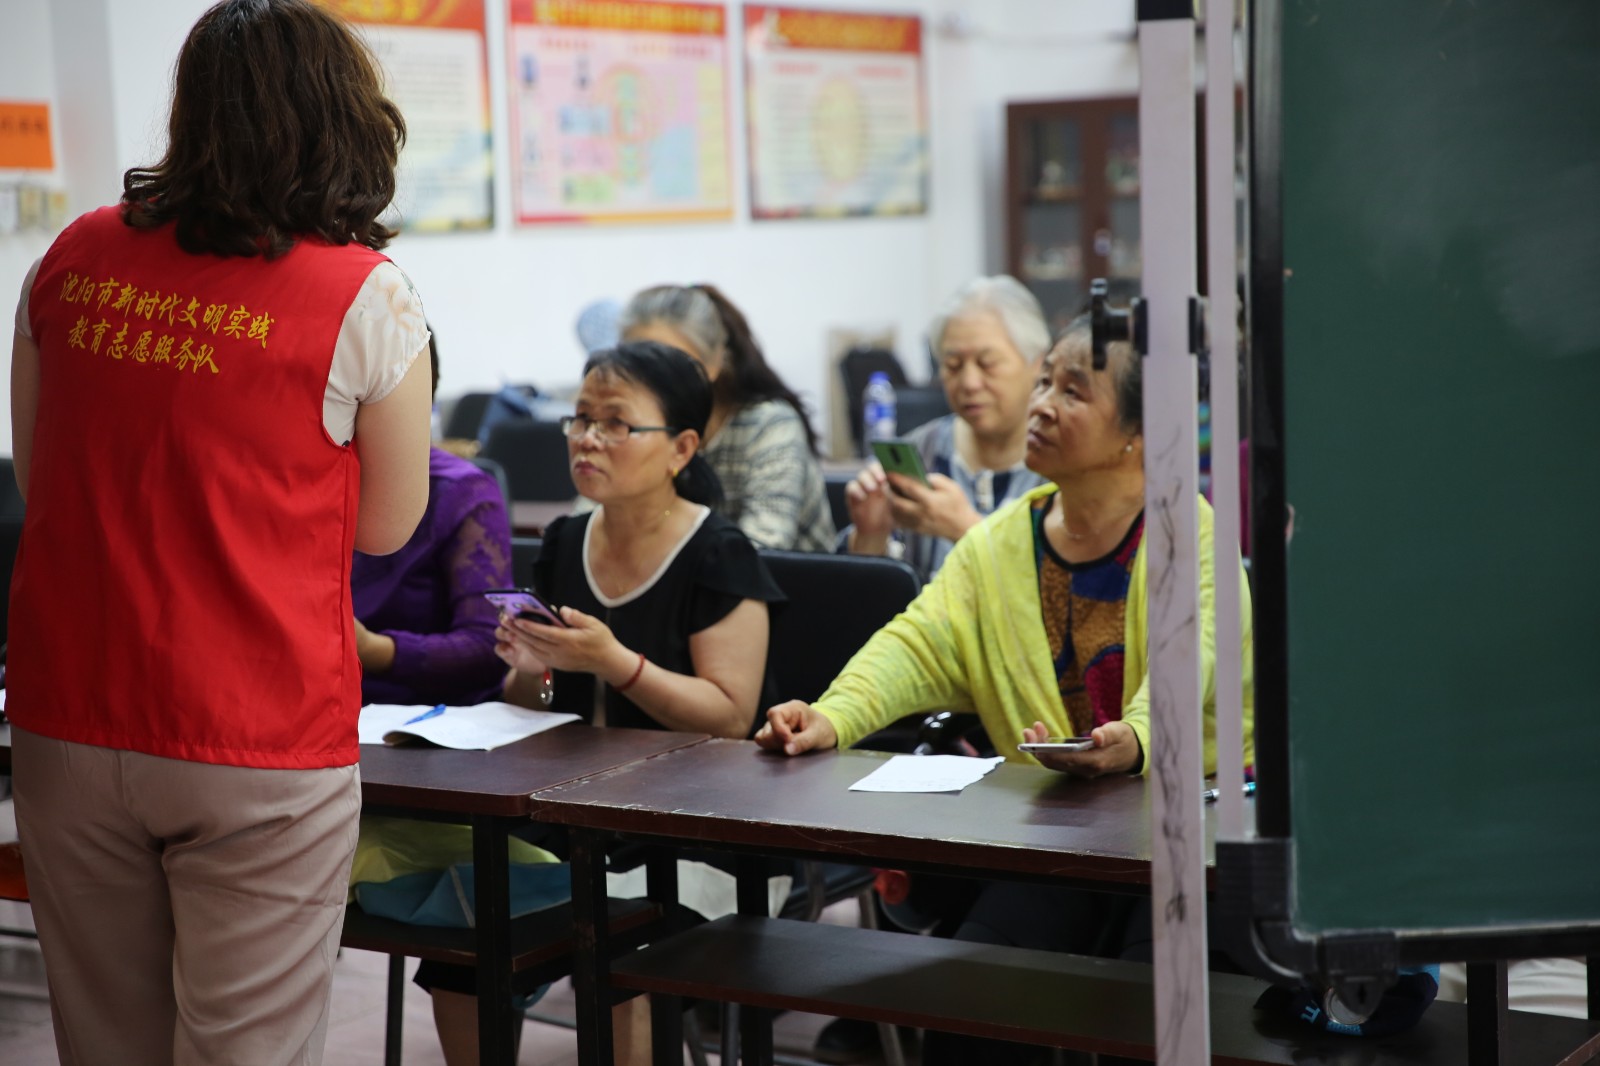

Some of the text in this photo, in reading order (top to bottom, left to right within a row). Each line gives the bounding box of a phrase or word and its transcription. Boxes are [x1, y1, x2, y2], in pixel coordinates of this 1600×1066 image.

[59, 272, 275, 349] 沈阳市新时代文明实践
[67, 315, 219, 374] 教育志愿服务队
